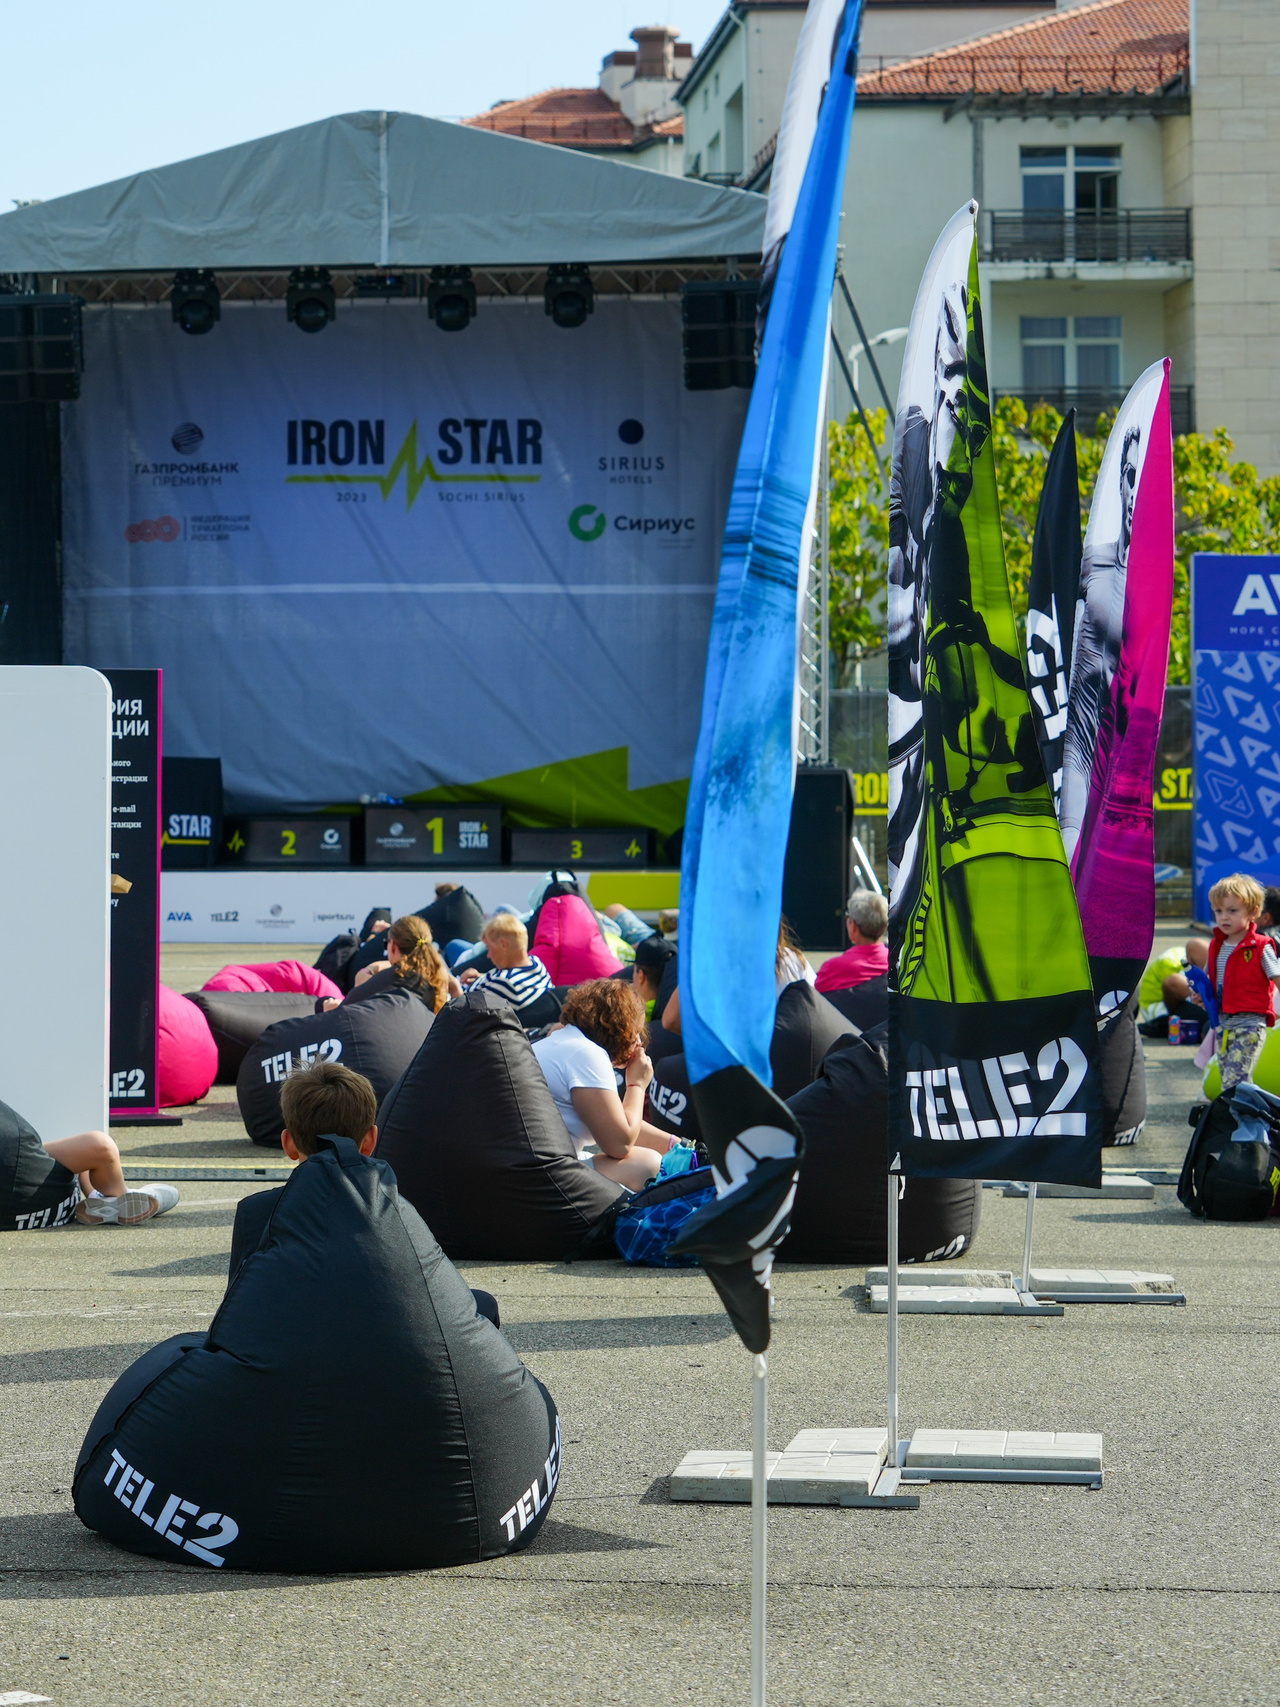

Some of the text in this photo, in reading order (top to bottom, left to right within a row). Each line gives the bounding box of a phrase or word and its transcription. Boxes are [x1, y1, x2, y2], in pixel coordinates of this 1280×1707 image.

[287, 418, 543, 466] IRON STAR
[134, 463, 239, 474] ГАЗПРОМБАНК
[598, 456, 665, 471] SIRIUS
[152, 476, 222, 487] ПРЕМИУМ
[609, 476, 653, 485] HOTELS
[336, 491, 525, 503] 2023 SOCHI SIRIUS
[614, 515, 695, 534] Сириус
[1161, 767, 1193, 800] ST
[113, 804, 136, 813] e-mail
[169, 814, 212, 838] STAR
[459, 821, 481, 833] IRON
[281, 830, 297, 856] 2
[426, 817, 444, 855] 1
[459, 833, 489, 849] STAR
[571, 840, 583, 859] 3
[166, 911, 193, 922] AVA
[211, 911, 239, 922] TELE2
[905, 1036, 1089, 1141] TELE2
[103, 1448, 240, 1568] TELE2
